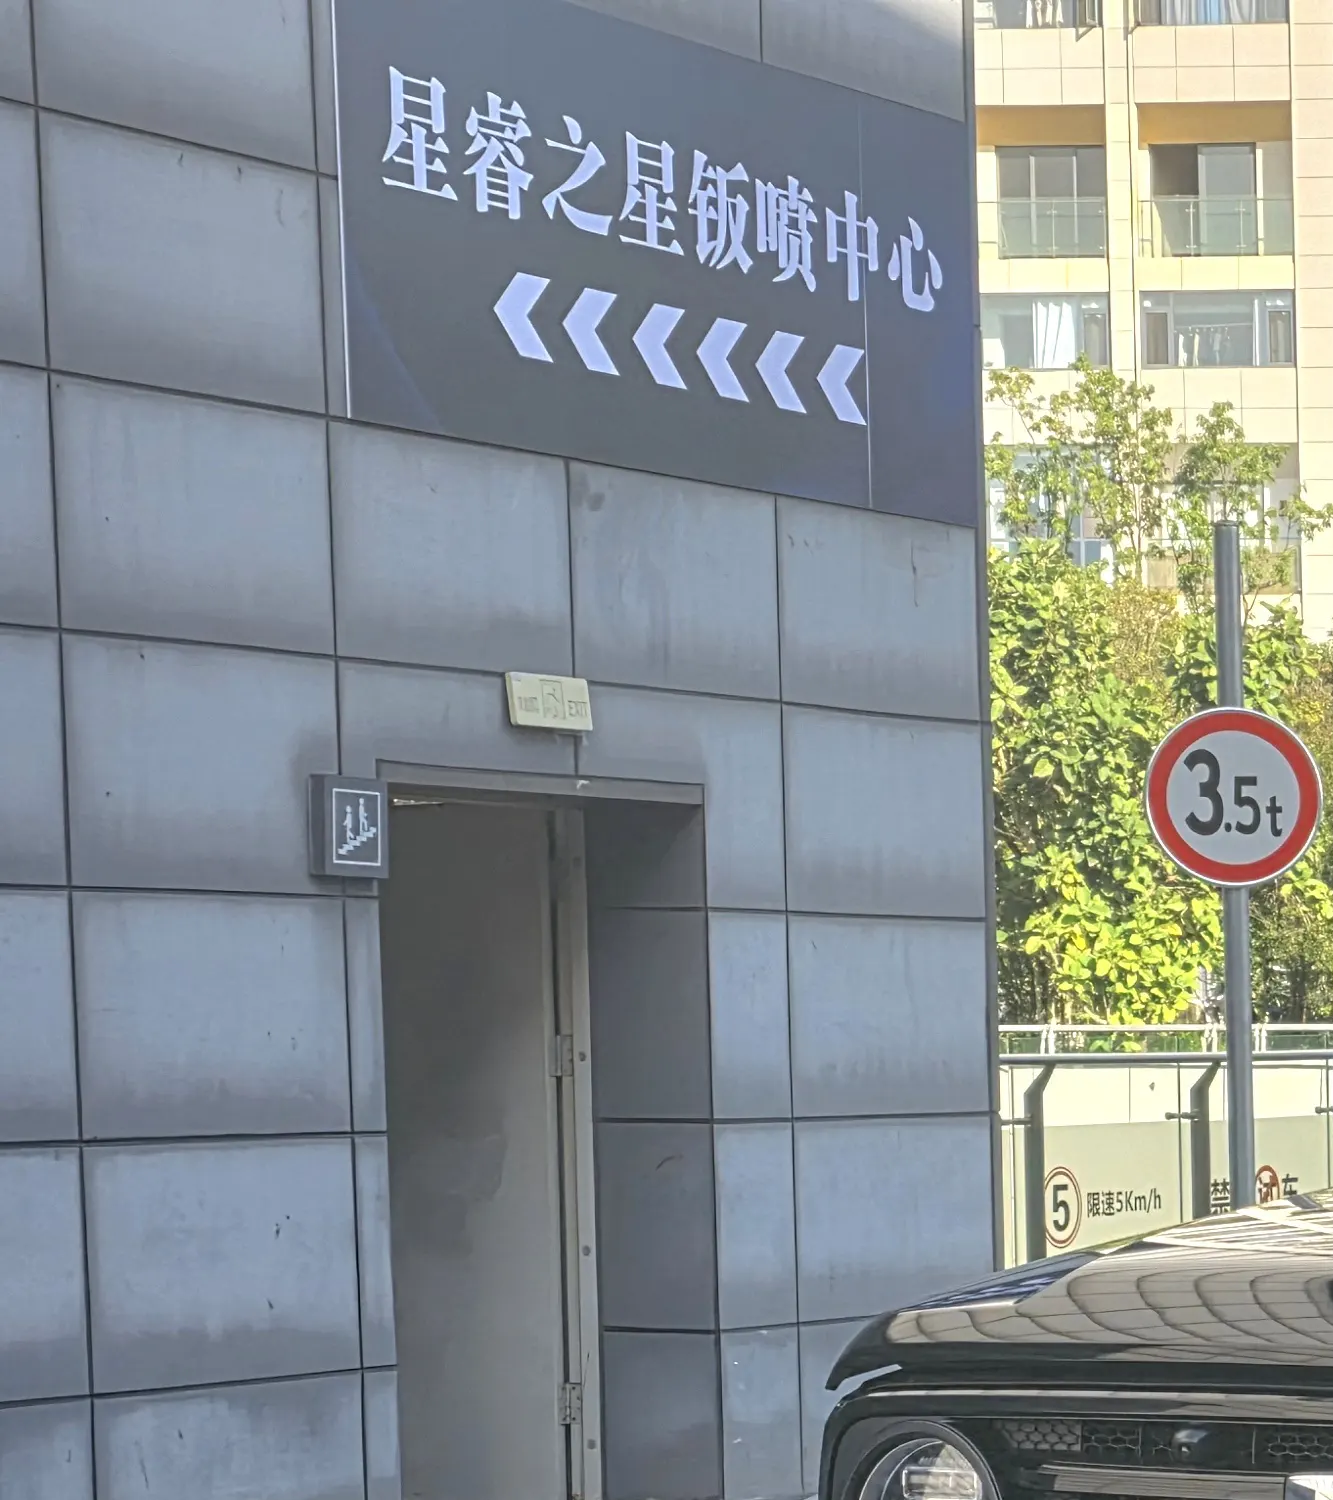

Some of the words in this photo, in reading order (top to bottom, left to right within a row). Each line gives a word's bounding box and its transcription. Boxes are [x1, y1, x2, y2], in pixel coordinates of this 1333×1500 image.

[382, 66, 943, 312] 星睿之星钣喷中心
[1184, 748, 1283, 837] 3.5t
[1053, 1184, 1070, 1232] 5
[1087, 1188, 1162, 1218] 限速5Km/h
